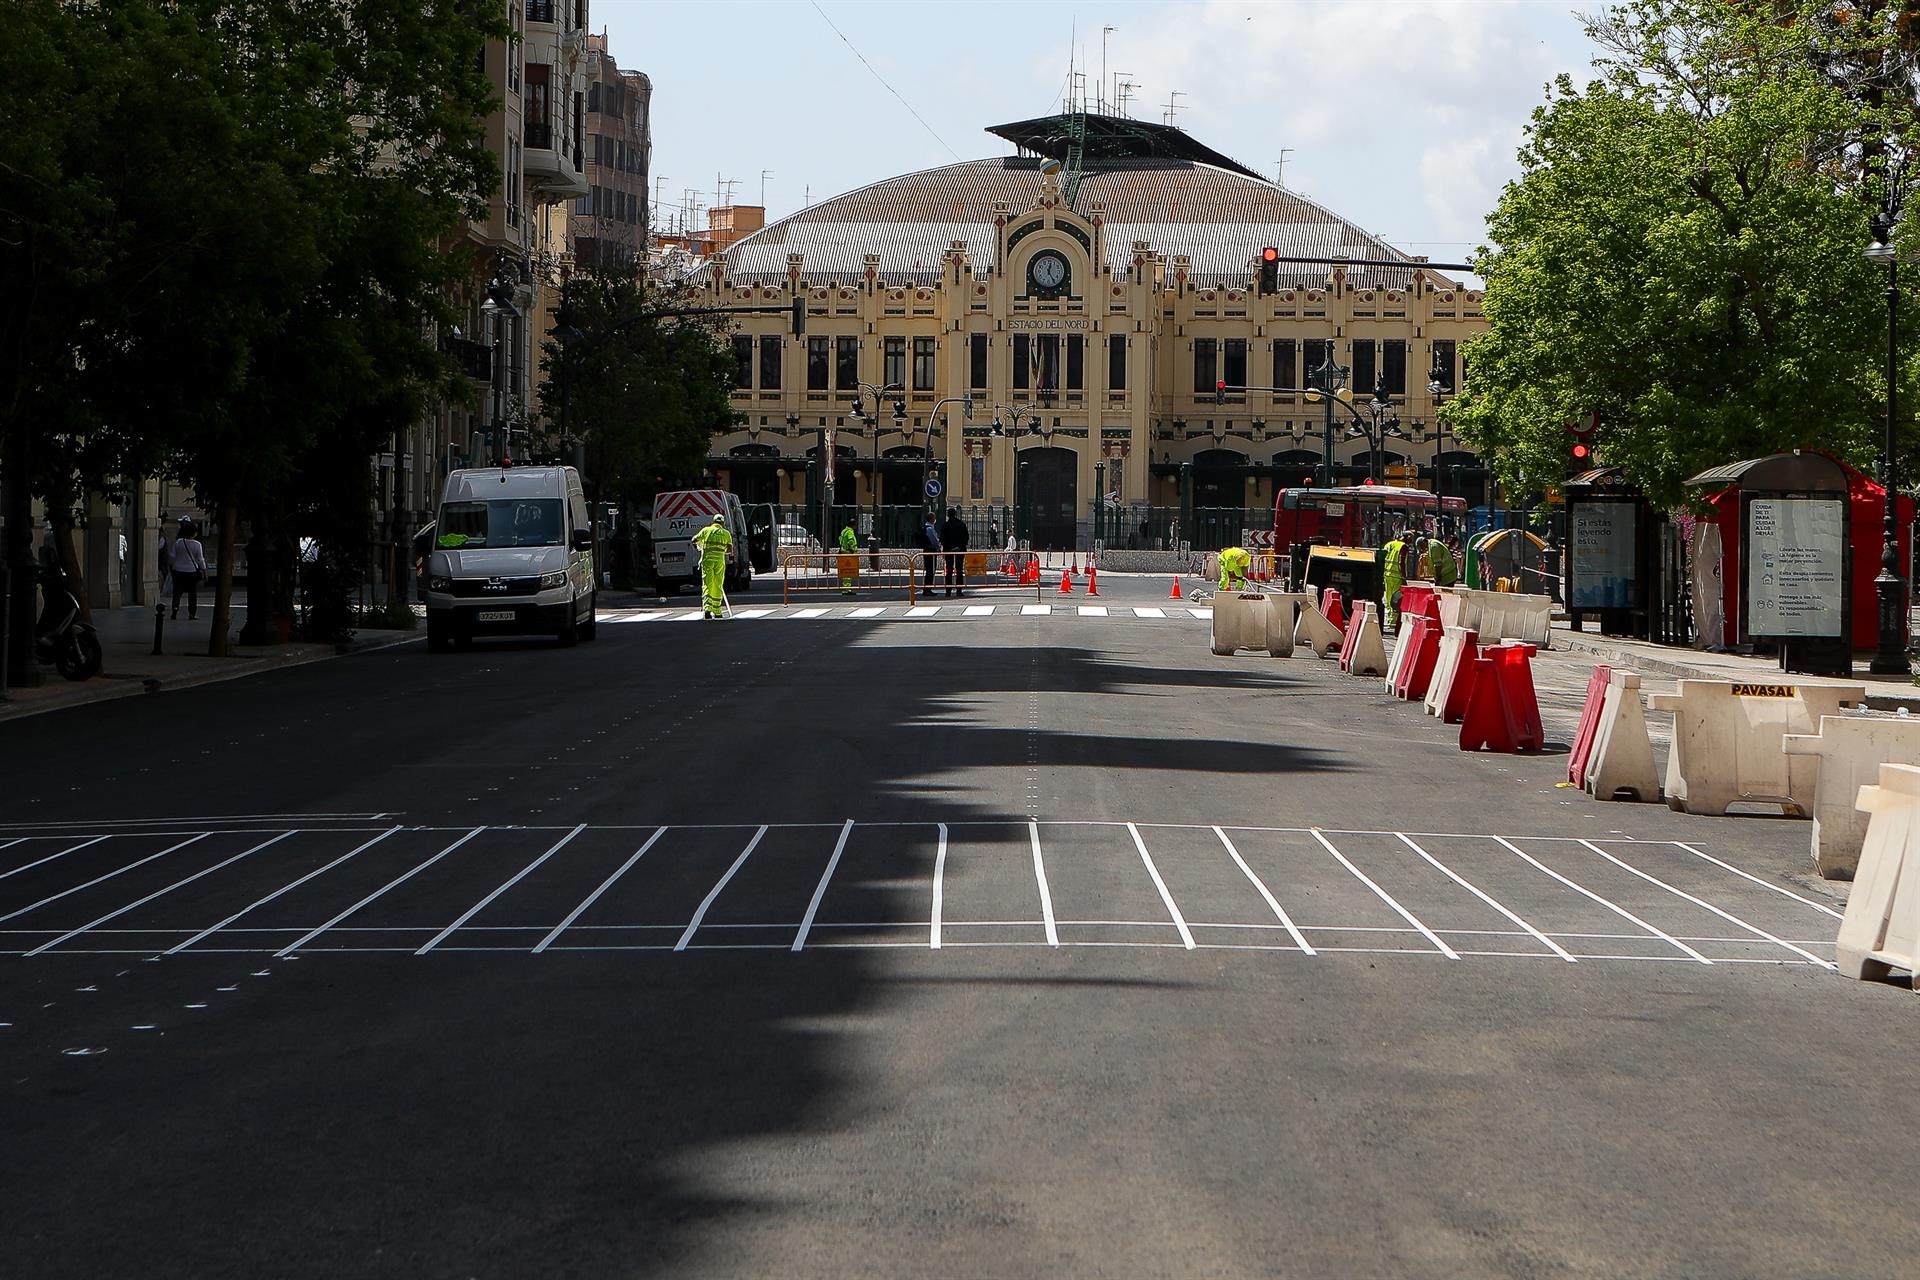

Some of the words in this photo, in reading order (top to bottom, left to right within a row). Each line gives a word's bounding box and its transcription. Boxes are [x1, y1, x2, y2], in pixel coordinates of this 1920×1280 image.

[1045, 319, 1063, 329] DEL
[1065, 319, 1089, 329] NORD
[669, 520, 690, 529] API
[1577, 518, 1586, 527] Si
[1588, 518, 1612, 527] estás
[1577, 528, 1612, 537] leyendo
[1731, 684, 1794, 698] PAVASAL
